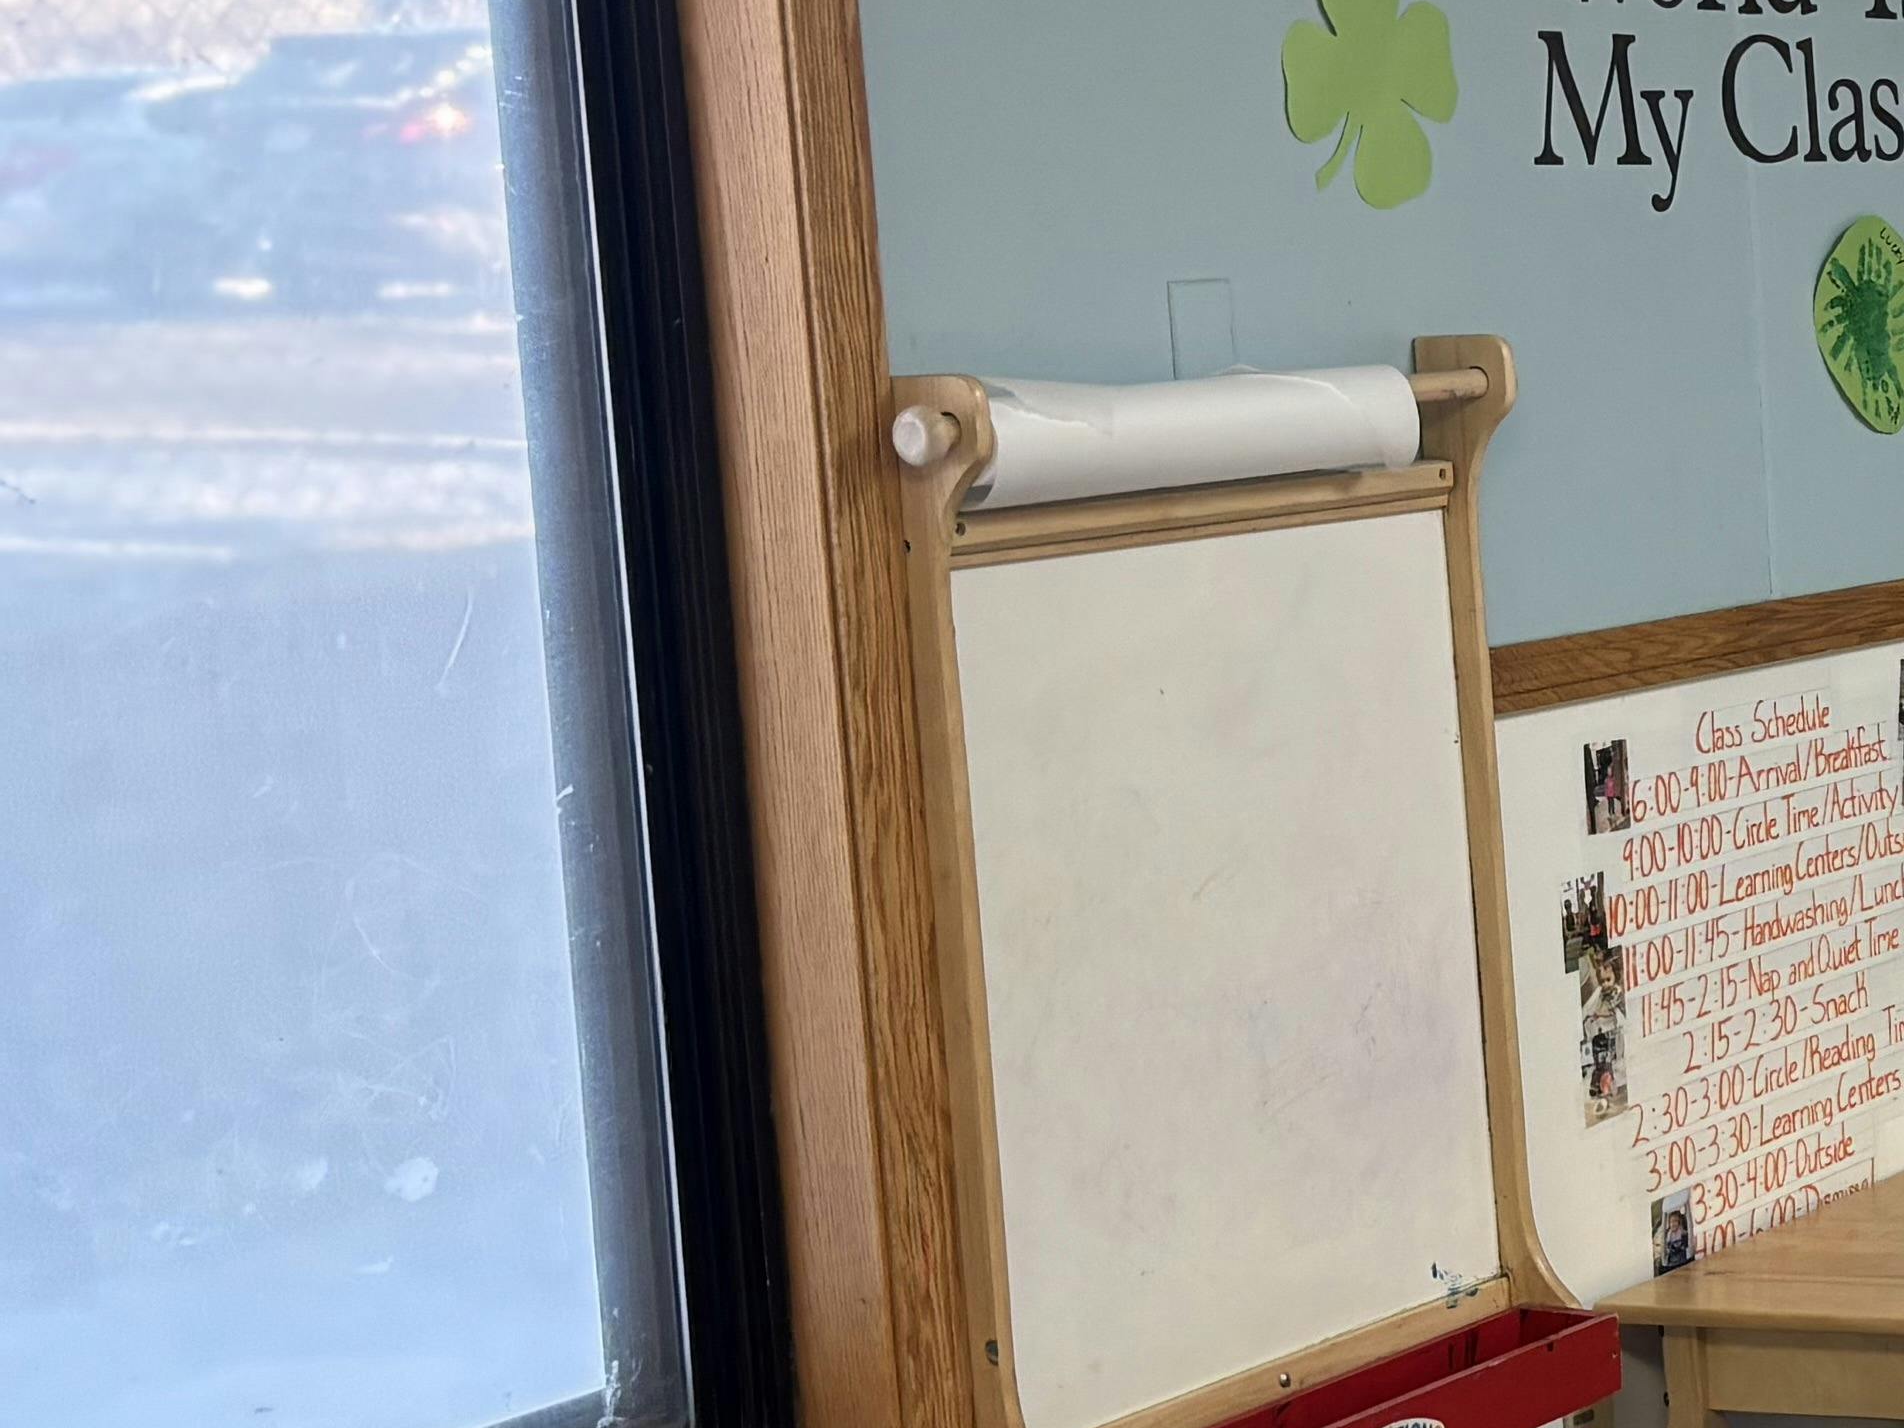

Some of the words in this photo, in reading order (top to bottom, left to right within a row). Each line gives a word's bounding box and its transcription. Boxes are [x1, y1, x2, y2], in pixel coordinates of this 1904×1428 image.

[1534, 29, 1695, 213] My
[1696, 708, 1743, 754] Class
[1751, 692, 1831, 744] Schedule
[1817, 921, 1863, 974] Quiet
[1865, 917, 1900, 959] Time
[1836, 1058, 1902, 1114] Centers
